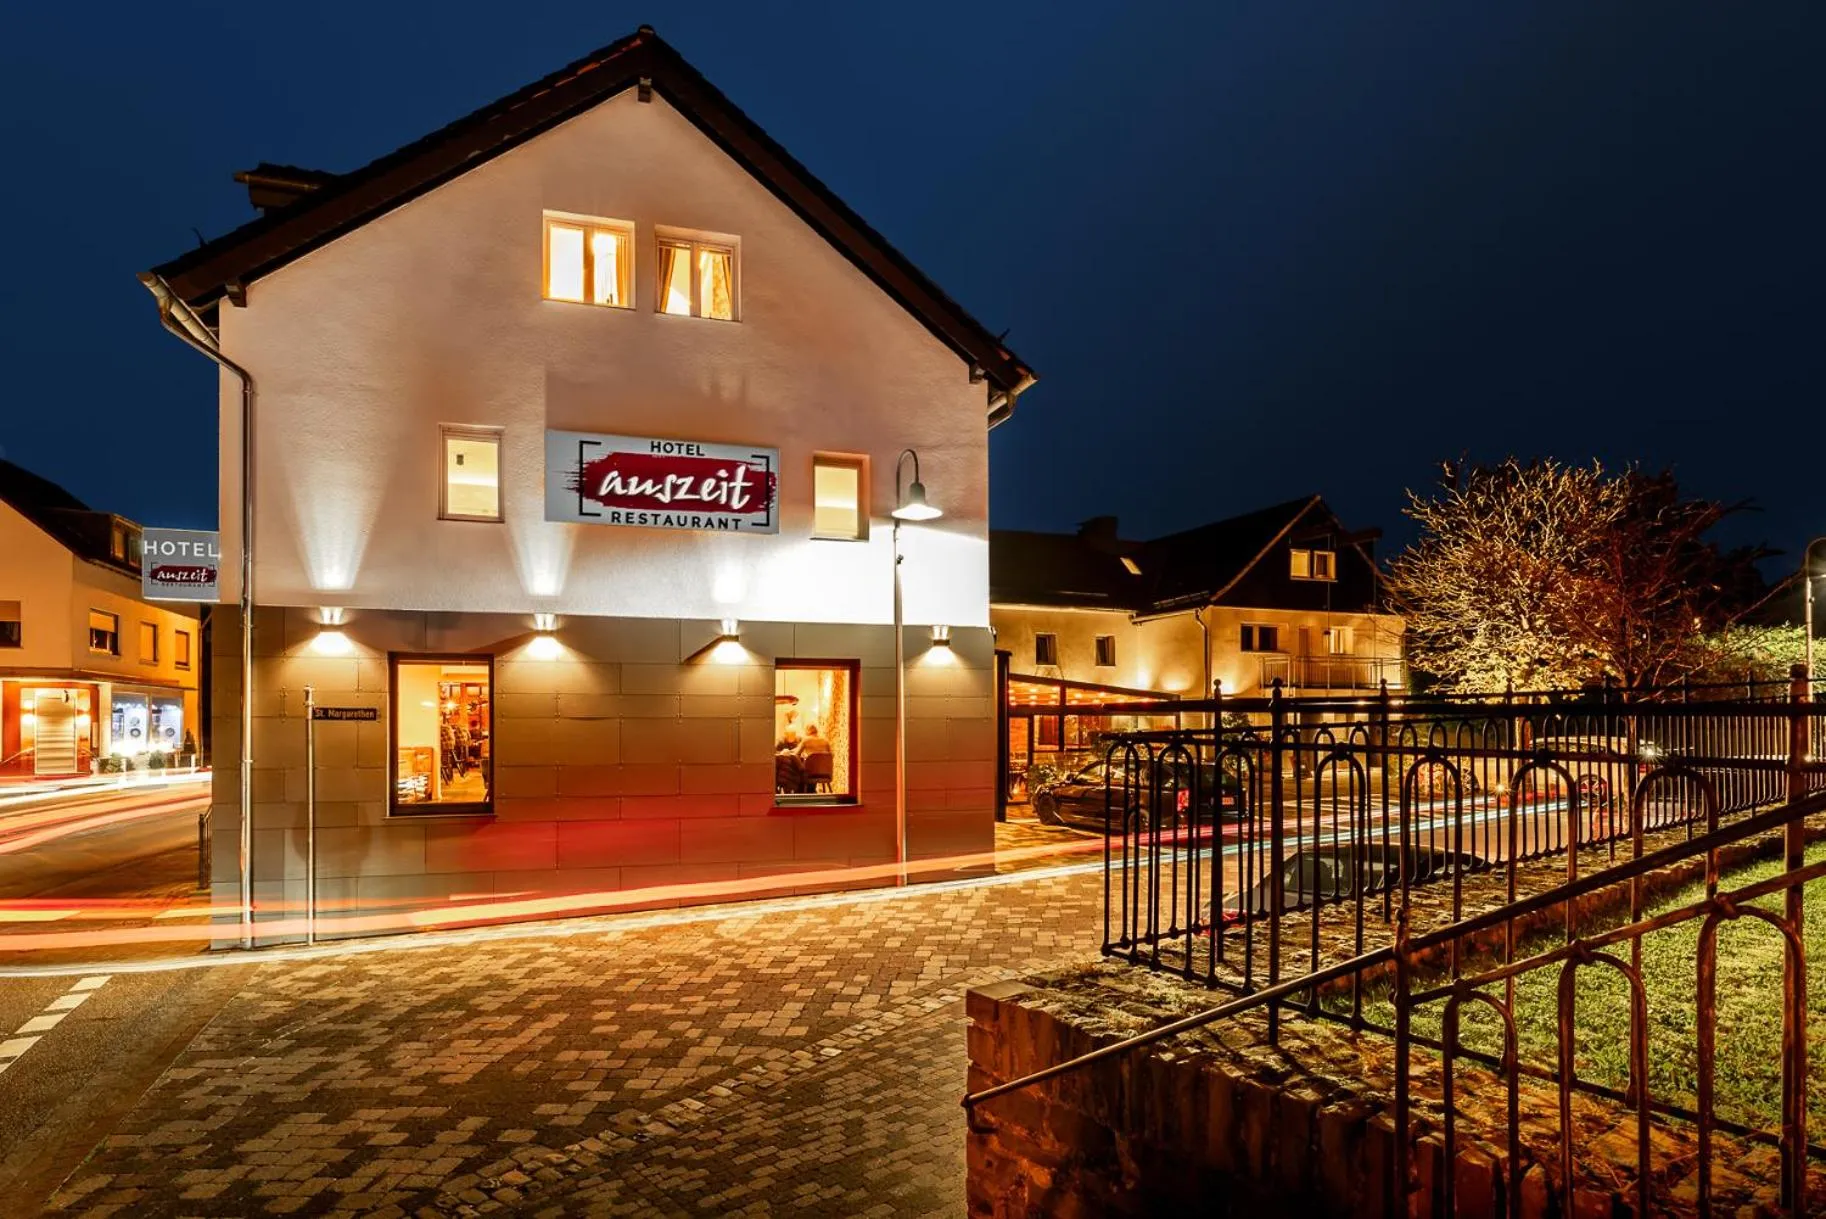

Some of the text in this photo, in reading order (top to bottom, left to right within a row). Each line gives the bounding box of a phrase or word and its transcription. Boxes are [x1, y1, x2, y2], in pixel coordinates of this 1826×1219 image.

[650, 441, 705, 457] HOTEL
[598, 464, 754, 510] auszeit
[611, 511, 742, 530] RESTAURANT
[144, 540, 219, 557] HOTEL
[157, 568, 208, 582] auszeit
